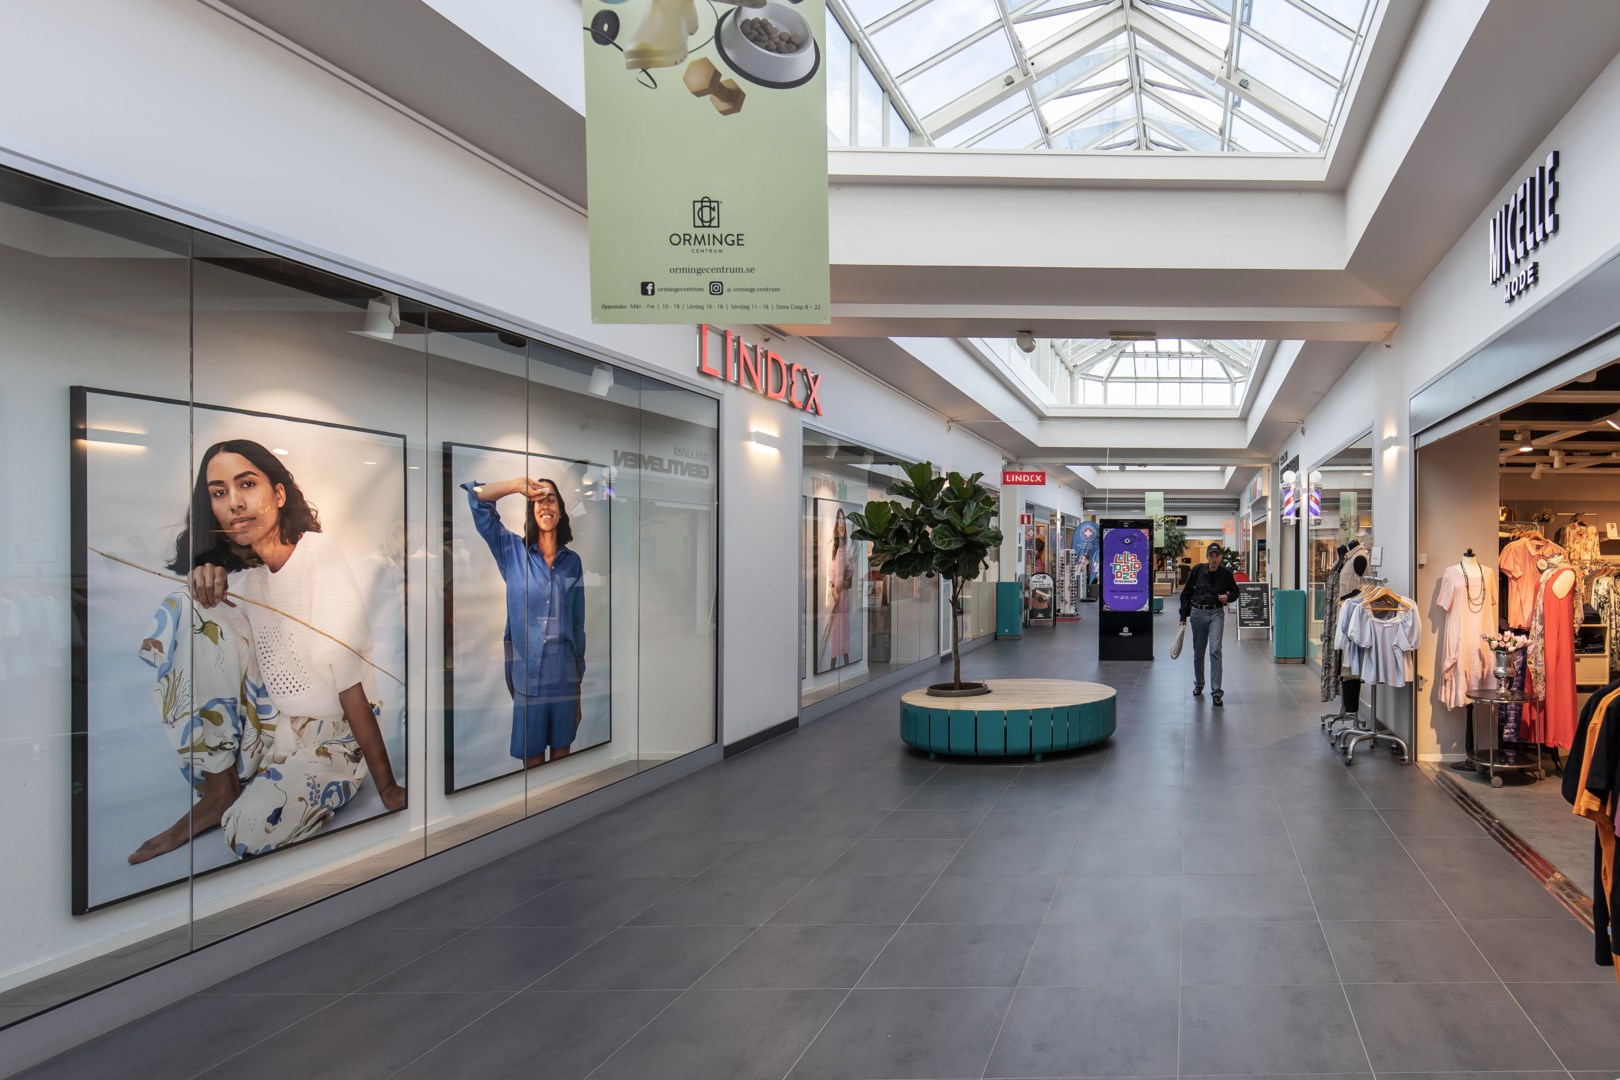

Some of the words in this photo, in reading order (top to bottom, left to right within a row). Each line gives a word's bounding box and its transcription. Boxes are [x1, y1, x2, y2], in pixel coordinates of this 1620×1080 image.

[1489, 150, 1560, 286] MICELLE
[669, 233, 745, 246] ORMINGE
[669, 265, 756, 276] ormingecentrum.se
[1504, 261, 1539, 303] MODE
[730, 303, 750, 311] Söndag
[790, 303, 804, 311] Coop
[700, 323, 823, 417] LINDEX
[1006, 474, 1042, 482] LINDEX
